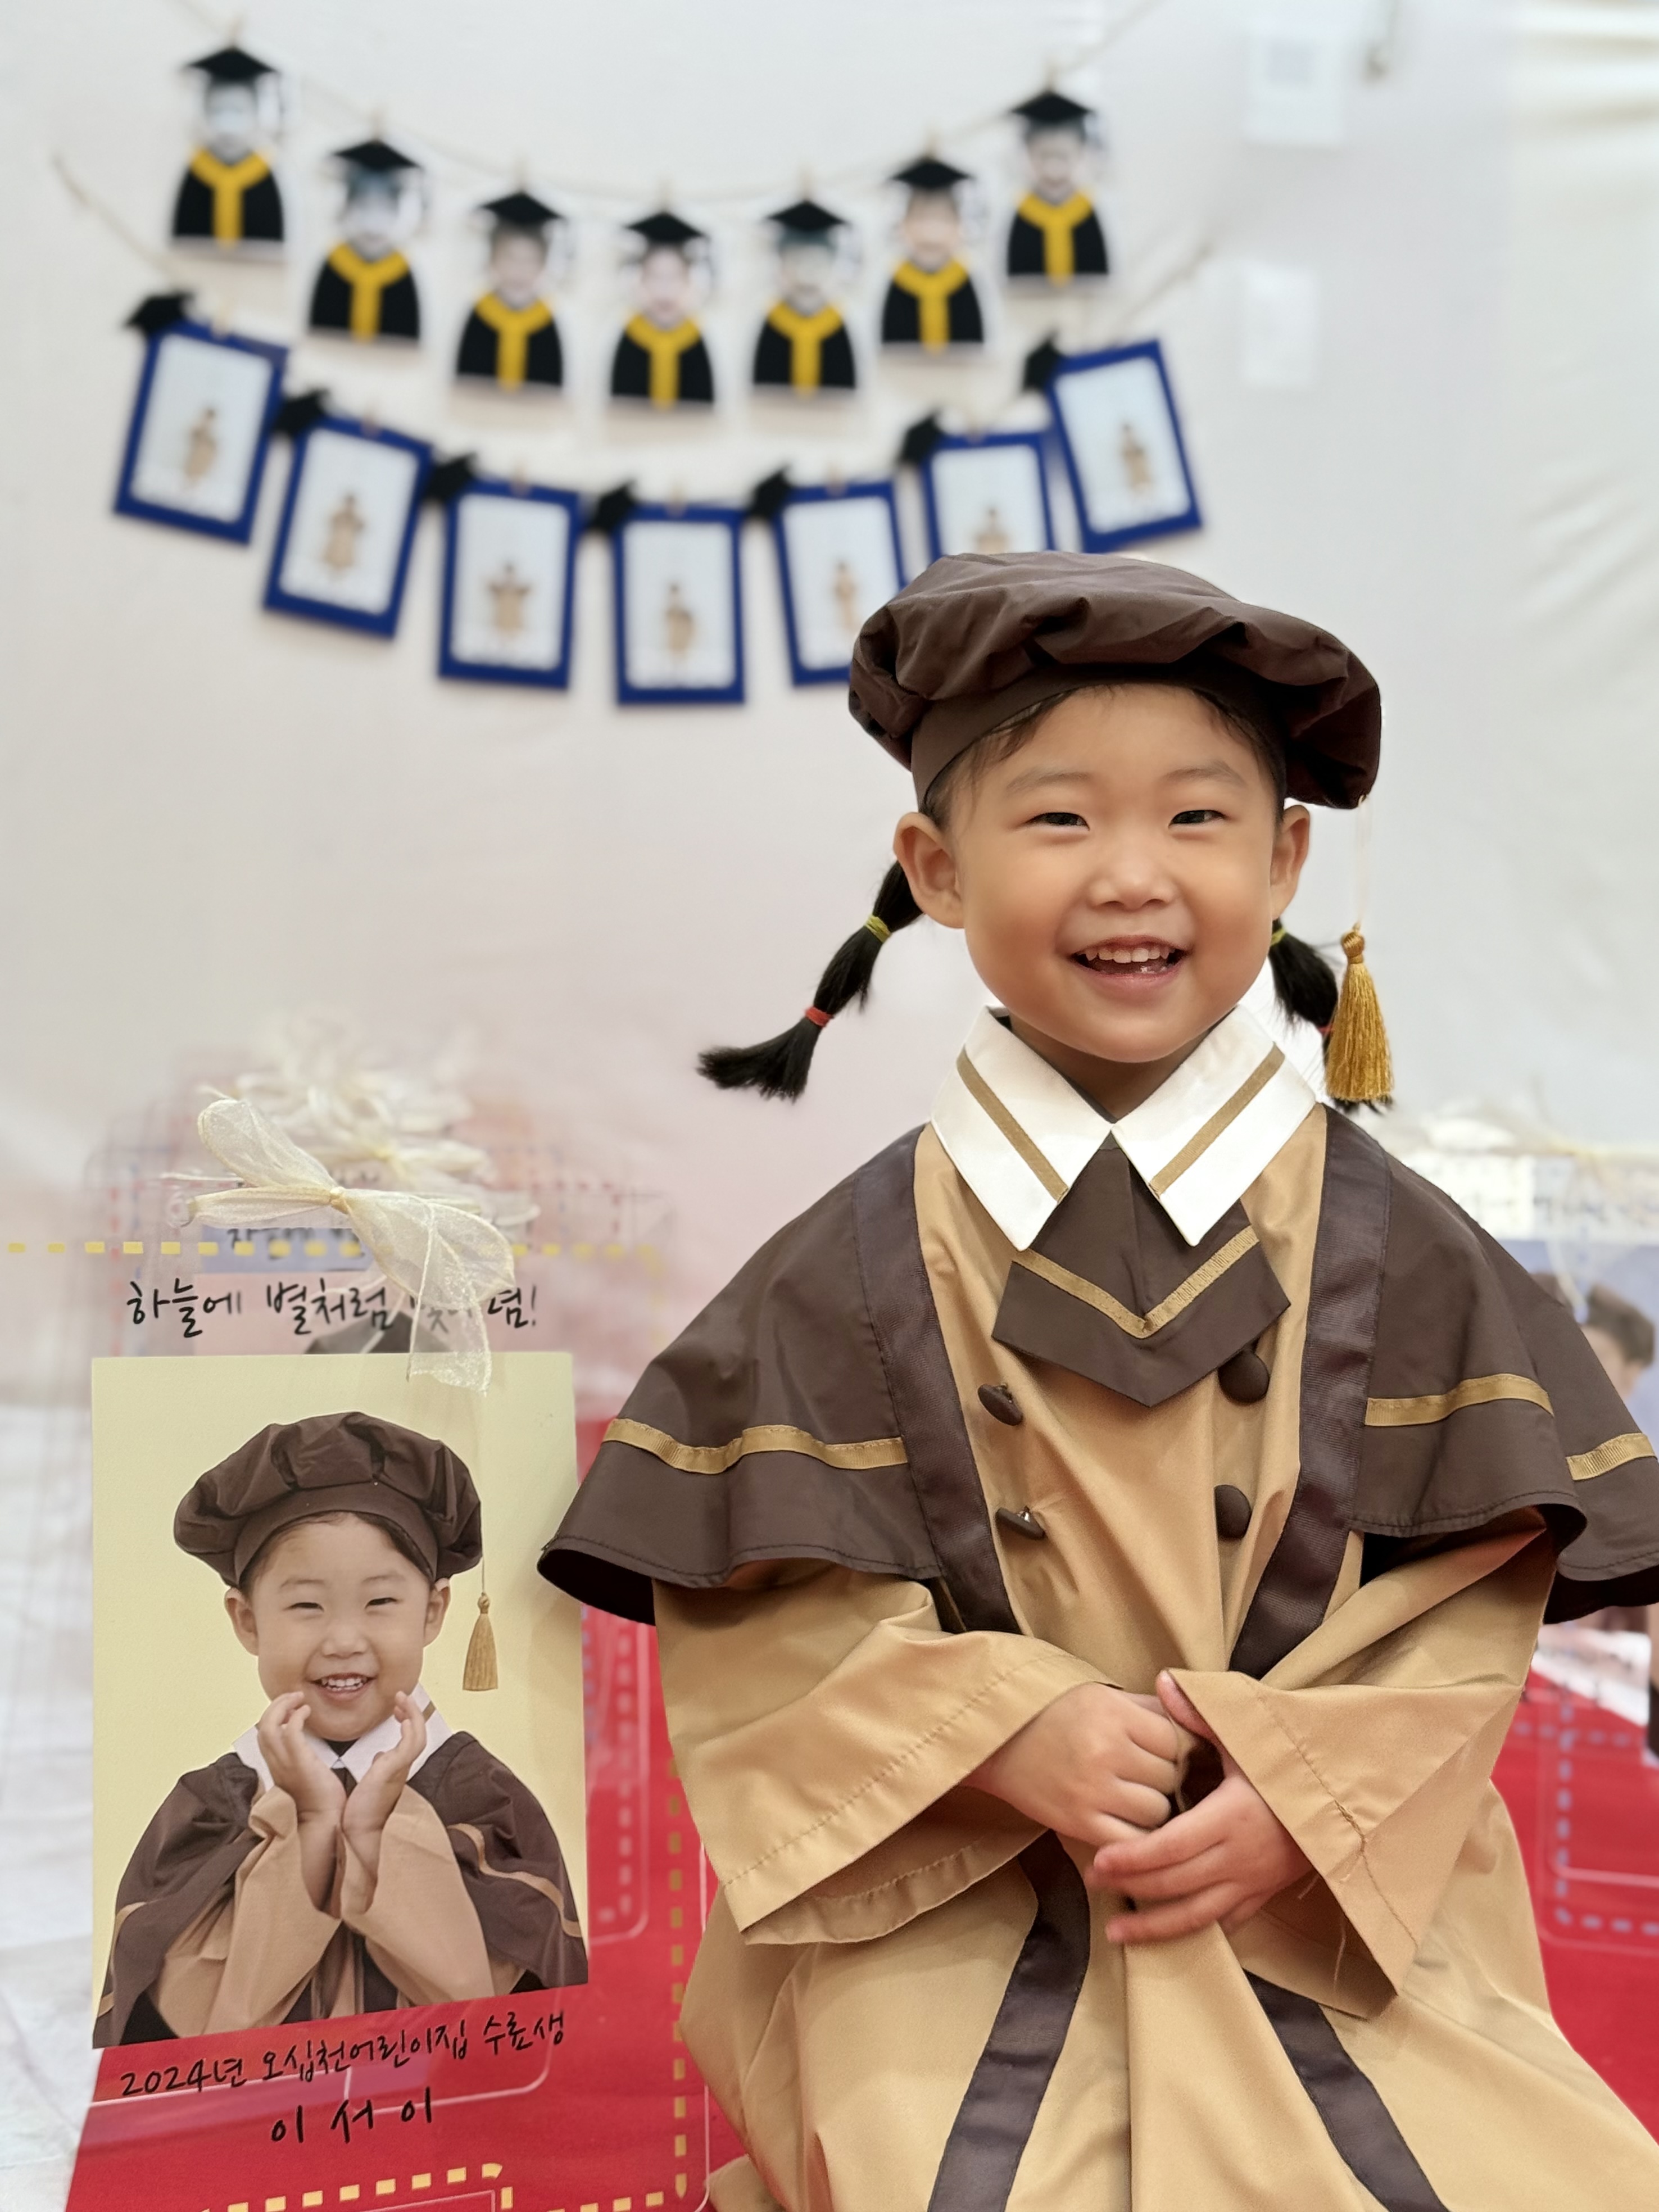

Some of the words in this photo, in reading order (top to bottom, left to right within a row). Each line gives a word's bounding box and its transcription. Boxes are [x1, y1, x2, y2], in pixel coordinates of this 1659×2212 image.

[126, 1277, 242, 1339] 하늘에
[266, 1277, 395, 1336] 별처럼
[120, 2057, 248, 2096] 2024년
[262, 2019, 468, 2083] 오십천어린이집
[482, 2009, 564, 2056] 수료생
